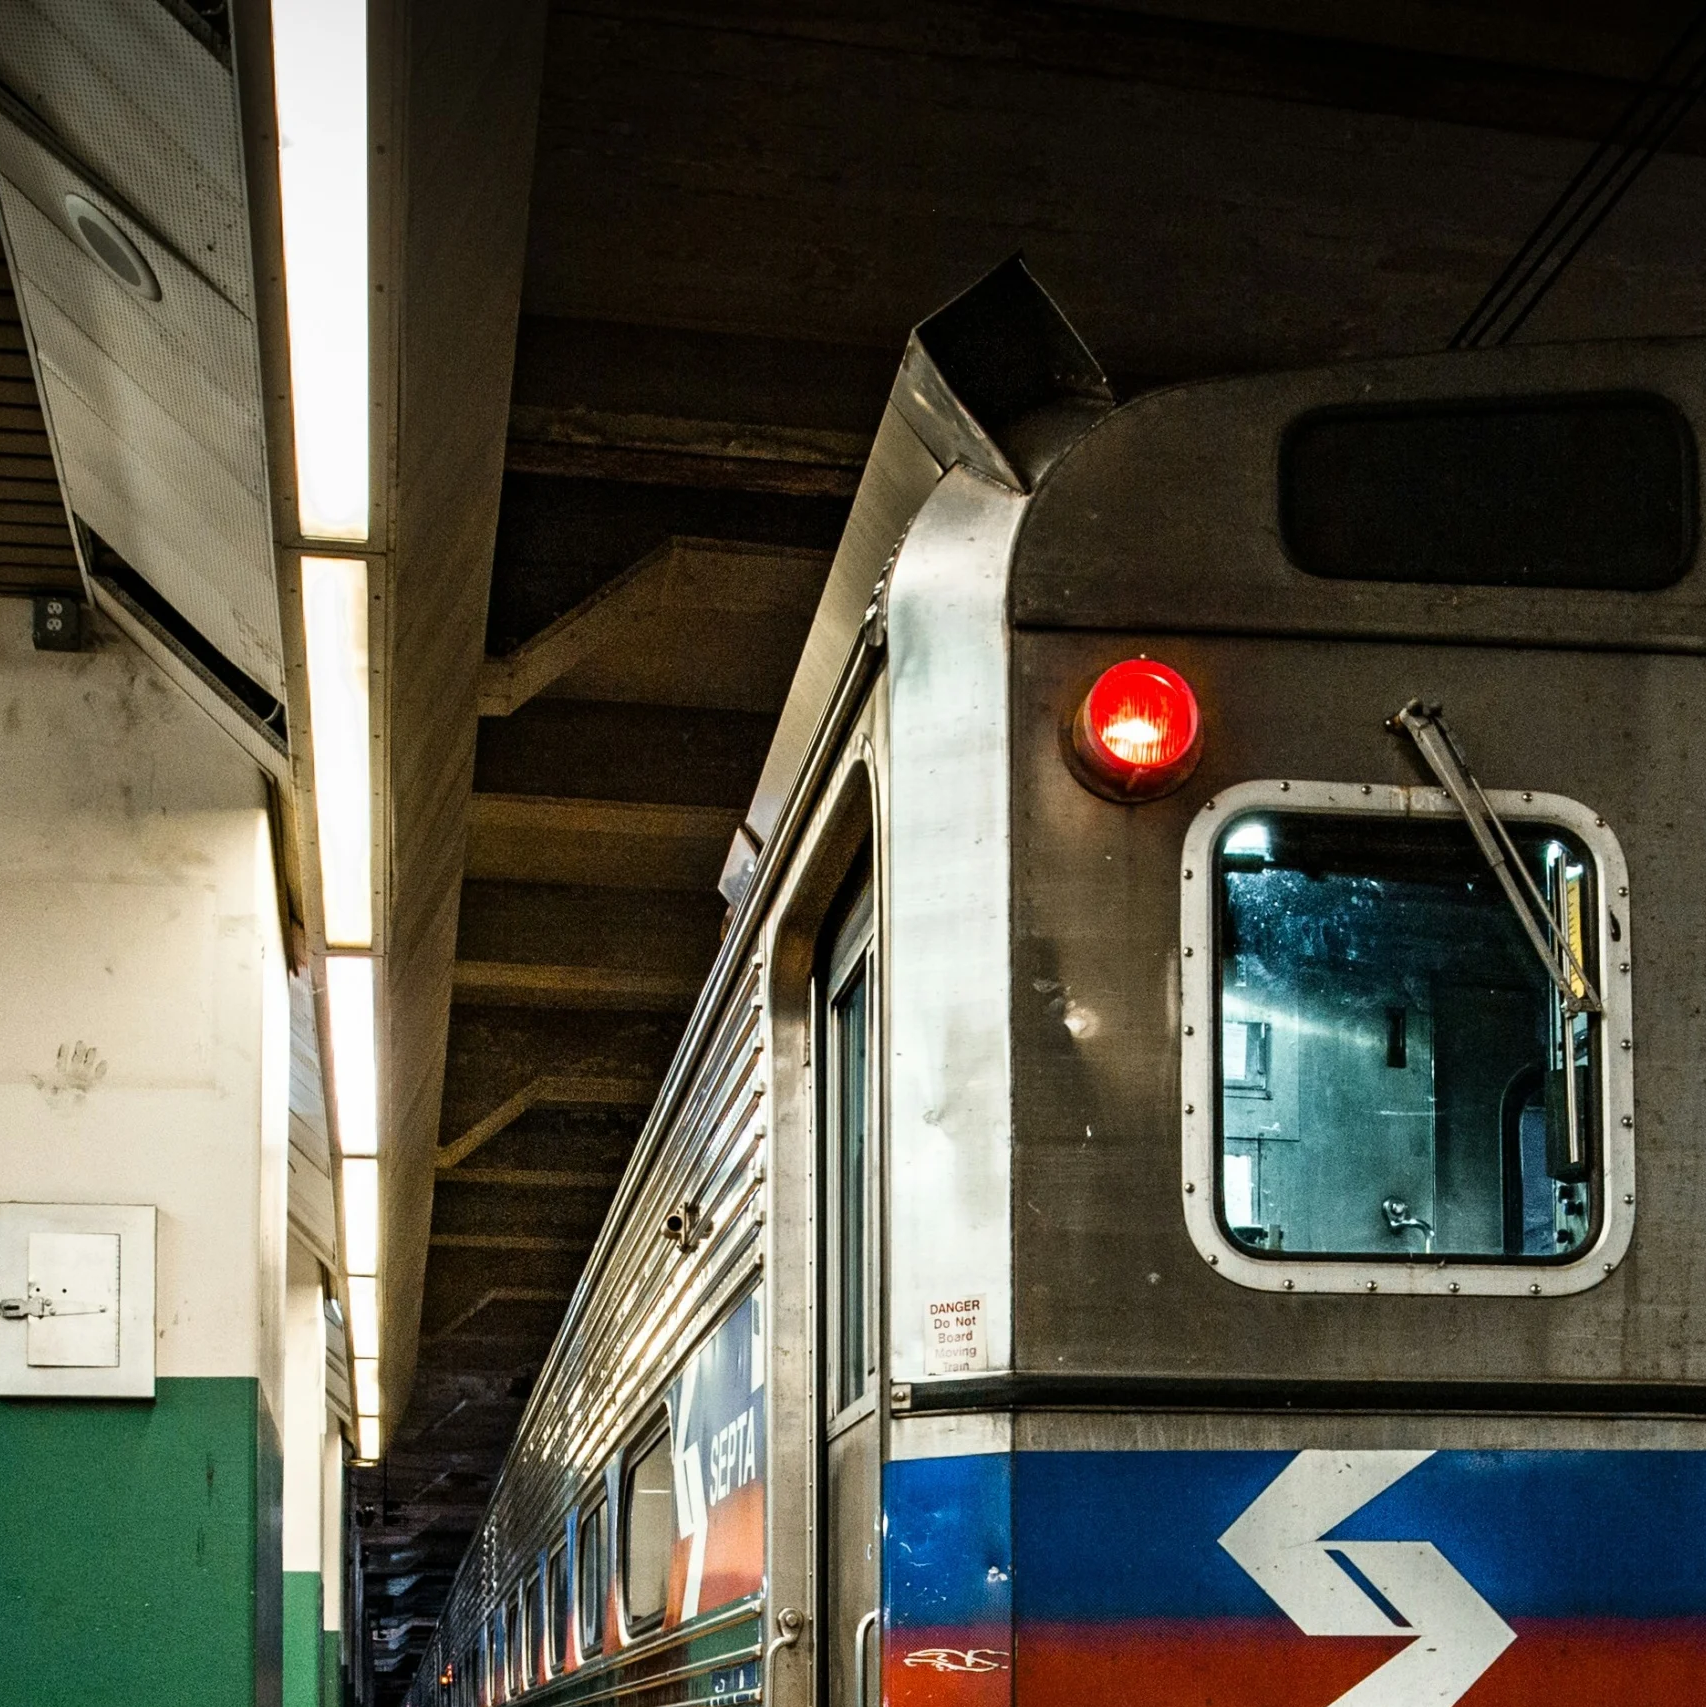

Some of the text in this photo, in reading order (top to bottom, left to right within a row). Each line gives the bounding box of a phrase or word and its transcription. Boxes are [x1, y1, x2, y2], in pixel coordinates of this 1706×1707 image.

[929, 1299, 981, 1315] DANGER
[933, 1316, 977, 1330] Do Not
[937, 1330, 974, 1344] Board
[934, 1346, 978, 1359] Moving
[943, 1362, 970, 1373] Train
[709, 1406, 756, 1507] SEPTA
